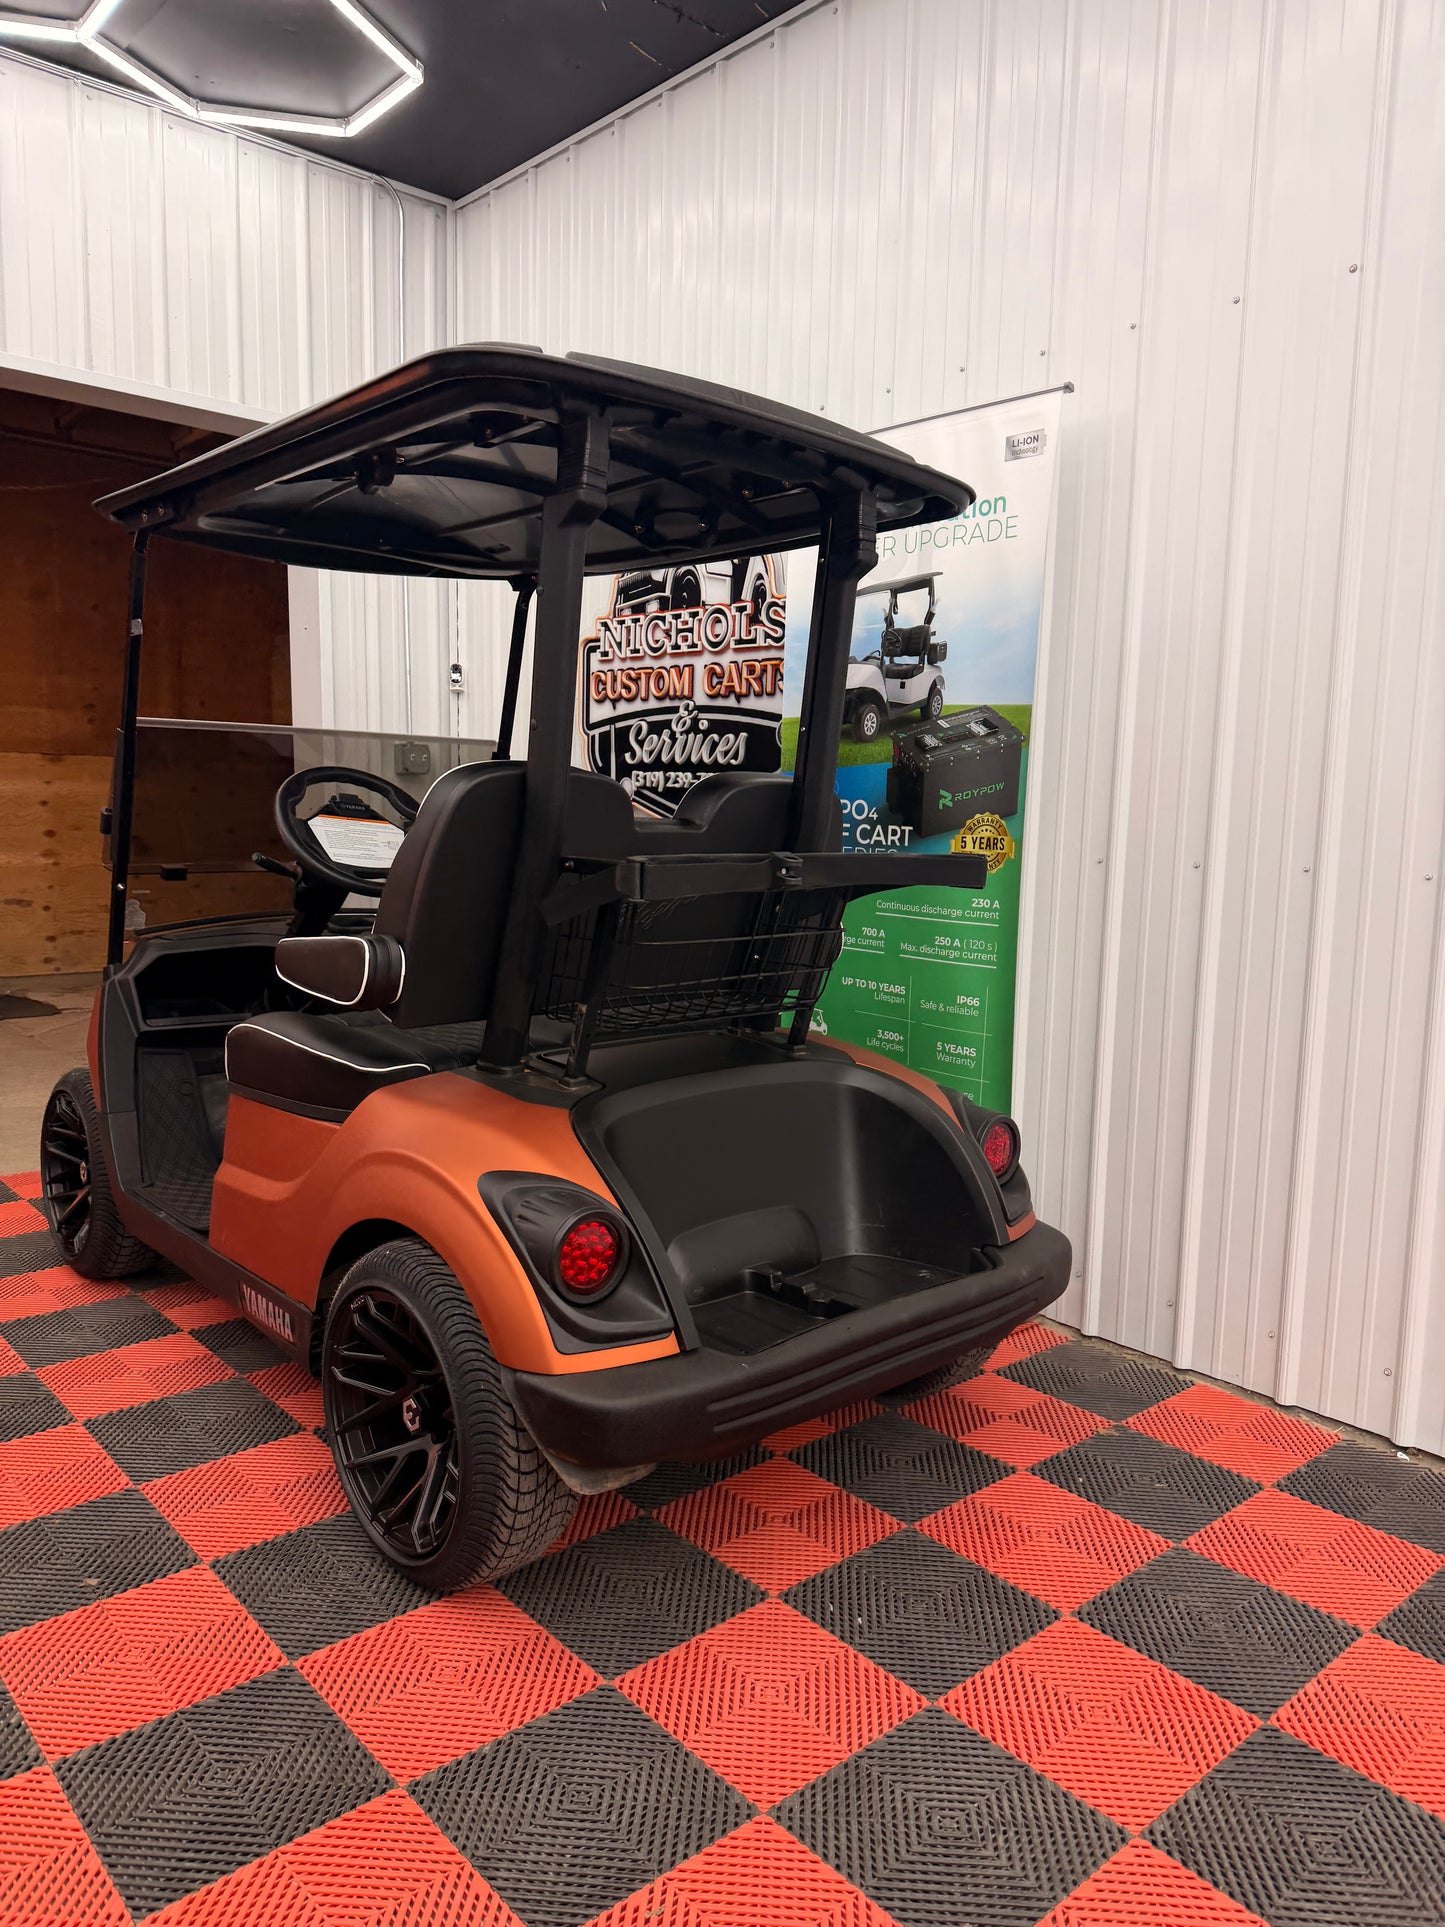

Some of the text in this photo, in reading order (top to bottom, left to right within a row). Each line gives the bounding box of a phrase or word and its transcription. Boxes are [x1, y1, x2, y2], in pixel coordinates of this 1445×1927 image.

[1012, 434, 1039, 448] LI-ION
[904, 515, 1018, 554] UPGRADE
[597, 599, 786, 660] NICHOLS
[590, 664, 694, 702] CUSTOM
[671, 700, 698, 734] &
[624, 719, 748, 765] Services
[631, 770, 664, 792] (319)
[954, 782, 1005, 801] ROYPOW
[967, 817, 1003, 832] WARRANTY
[856, 823, 914, 847] CART
[960, 836, 1005, 851] 5 YEARS
[876, 899, 1000, 920] Continuous discharge current
[971, 898, 1000, 909] 230 A
[861, 927, 886, 938] 700 A
[857, 938, 885, 948] current
[900, 942, 998, 962] Max. discharge current
[934, 936, 951, 946] 250
[952, 938, 961, 947] A
[969, 940, 985, 950] 120
[842, 976, 906, 995] UP TO 10 YEARS
[874, 991, 905, 1005] Lifespan
[956, 994, 980, 1007] IP66
[920, 999, 979, 1017] Safe & reliable
[877, 1029, 904, 1042] 3,500+
[866, 1037, 904, 1053] Life cycles
[936, 1041, 977, 1057] 5 YEARS
[936, 1051, 976, 1069] Warranty
[242, 1283, 294, 1343] YAMAHA
